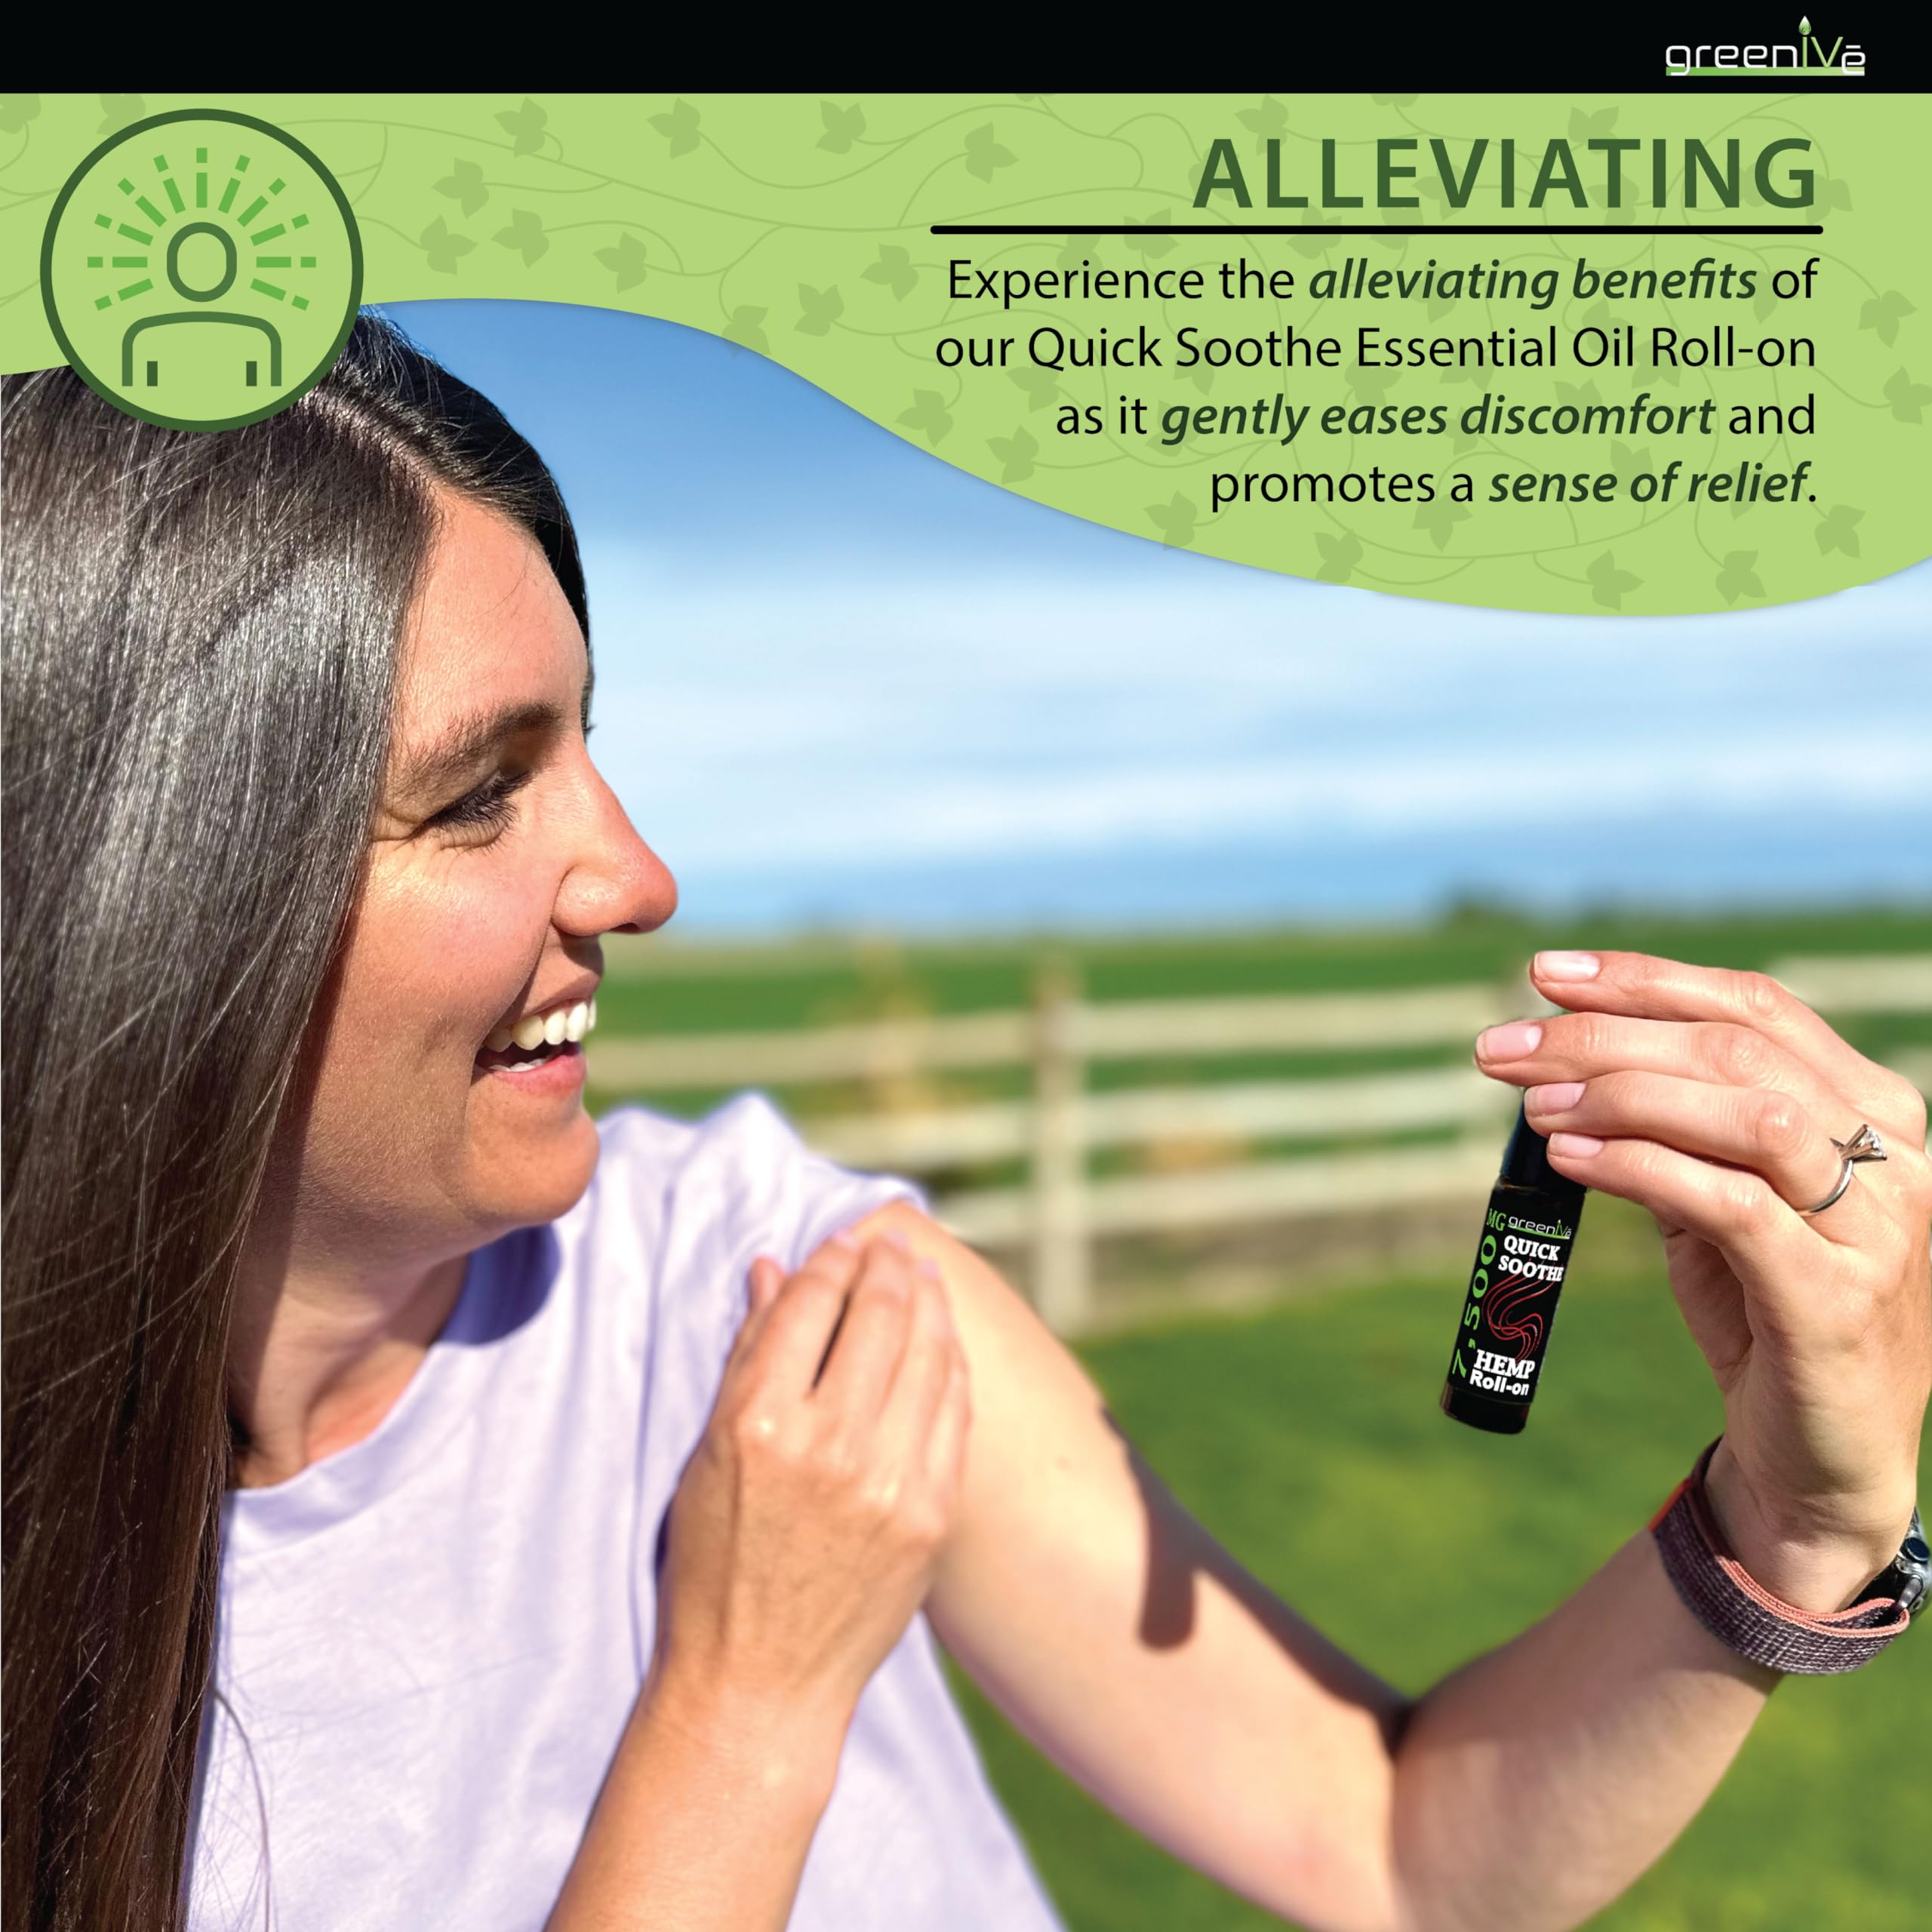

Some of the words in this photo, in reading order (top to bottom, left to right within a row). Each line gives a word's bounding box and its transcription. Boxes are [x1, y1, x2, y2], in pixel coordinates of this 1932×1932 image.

[1486, 1208, 1507, 1232] MG
[1503, 1235, 1561, 1261] QUICK
[1497, 1255, 1564, 1282] SOOTHE
[1473, 1349, 1536, 1380] HEMP
[1469, 1367, 1530, 1396] Roll-on
